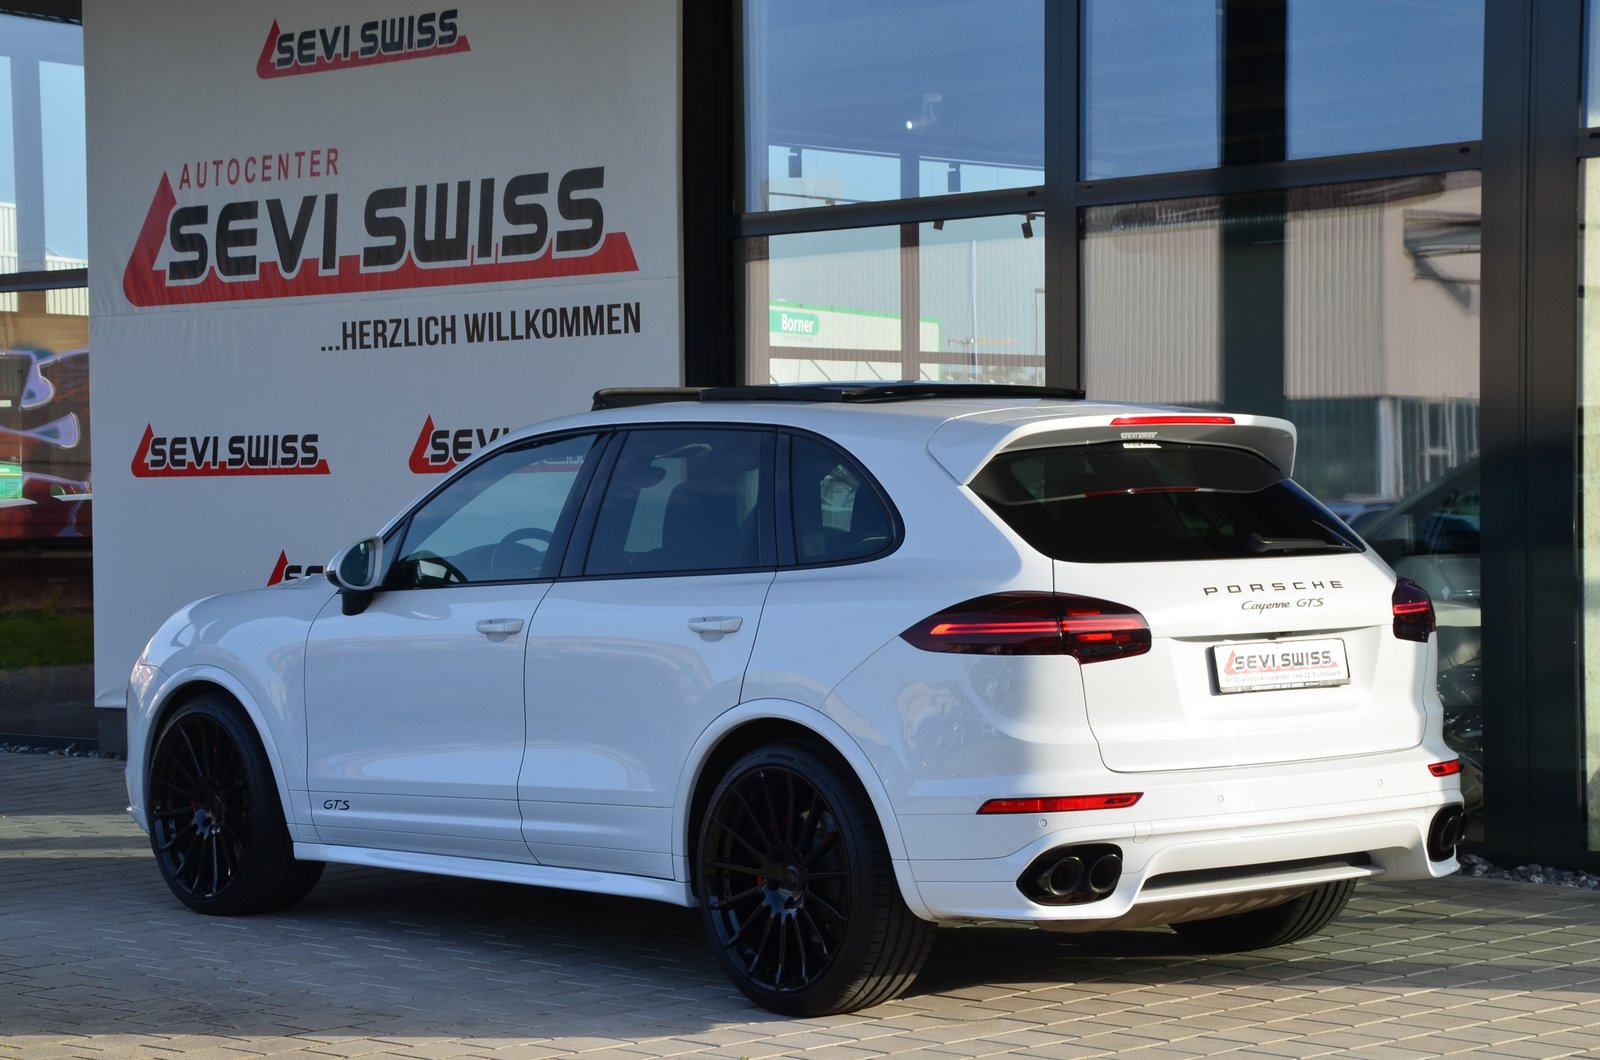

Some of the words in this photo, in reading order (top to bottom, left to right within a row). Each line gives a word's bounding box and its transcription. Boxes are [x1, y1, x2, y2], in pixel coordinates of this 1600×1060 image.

[276, 24, 351, 68] SEVI
[359, 8, 458, 57] SWISS
[178, 147, 340, 190] AUTOCENTER
[168, 192, 339, 281] SEVI
[363, 166, 605, 267] SWISS
[463, 301, 642, 345] WILLKOMMEN
[781, 313, 814, 333] Borner
[150, 436, 219, 467] SEVI
[227, 433, 319, 467] SWISS
[430, 427, 510, 463] SEV
[1203, 580, 1344, 596] PORSCHE
[1241, 600, 1291, 614] Cayenne
[1296, 597, 1324, 608] GTS
[1235, 654, 1276, 670] SEVI
[1280, 650, 1332, 668] SWISS
[323, 799, 350, 811] GTS
